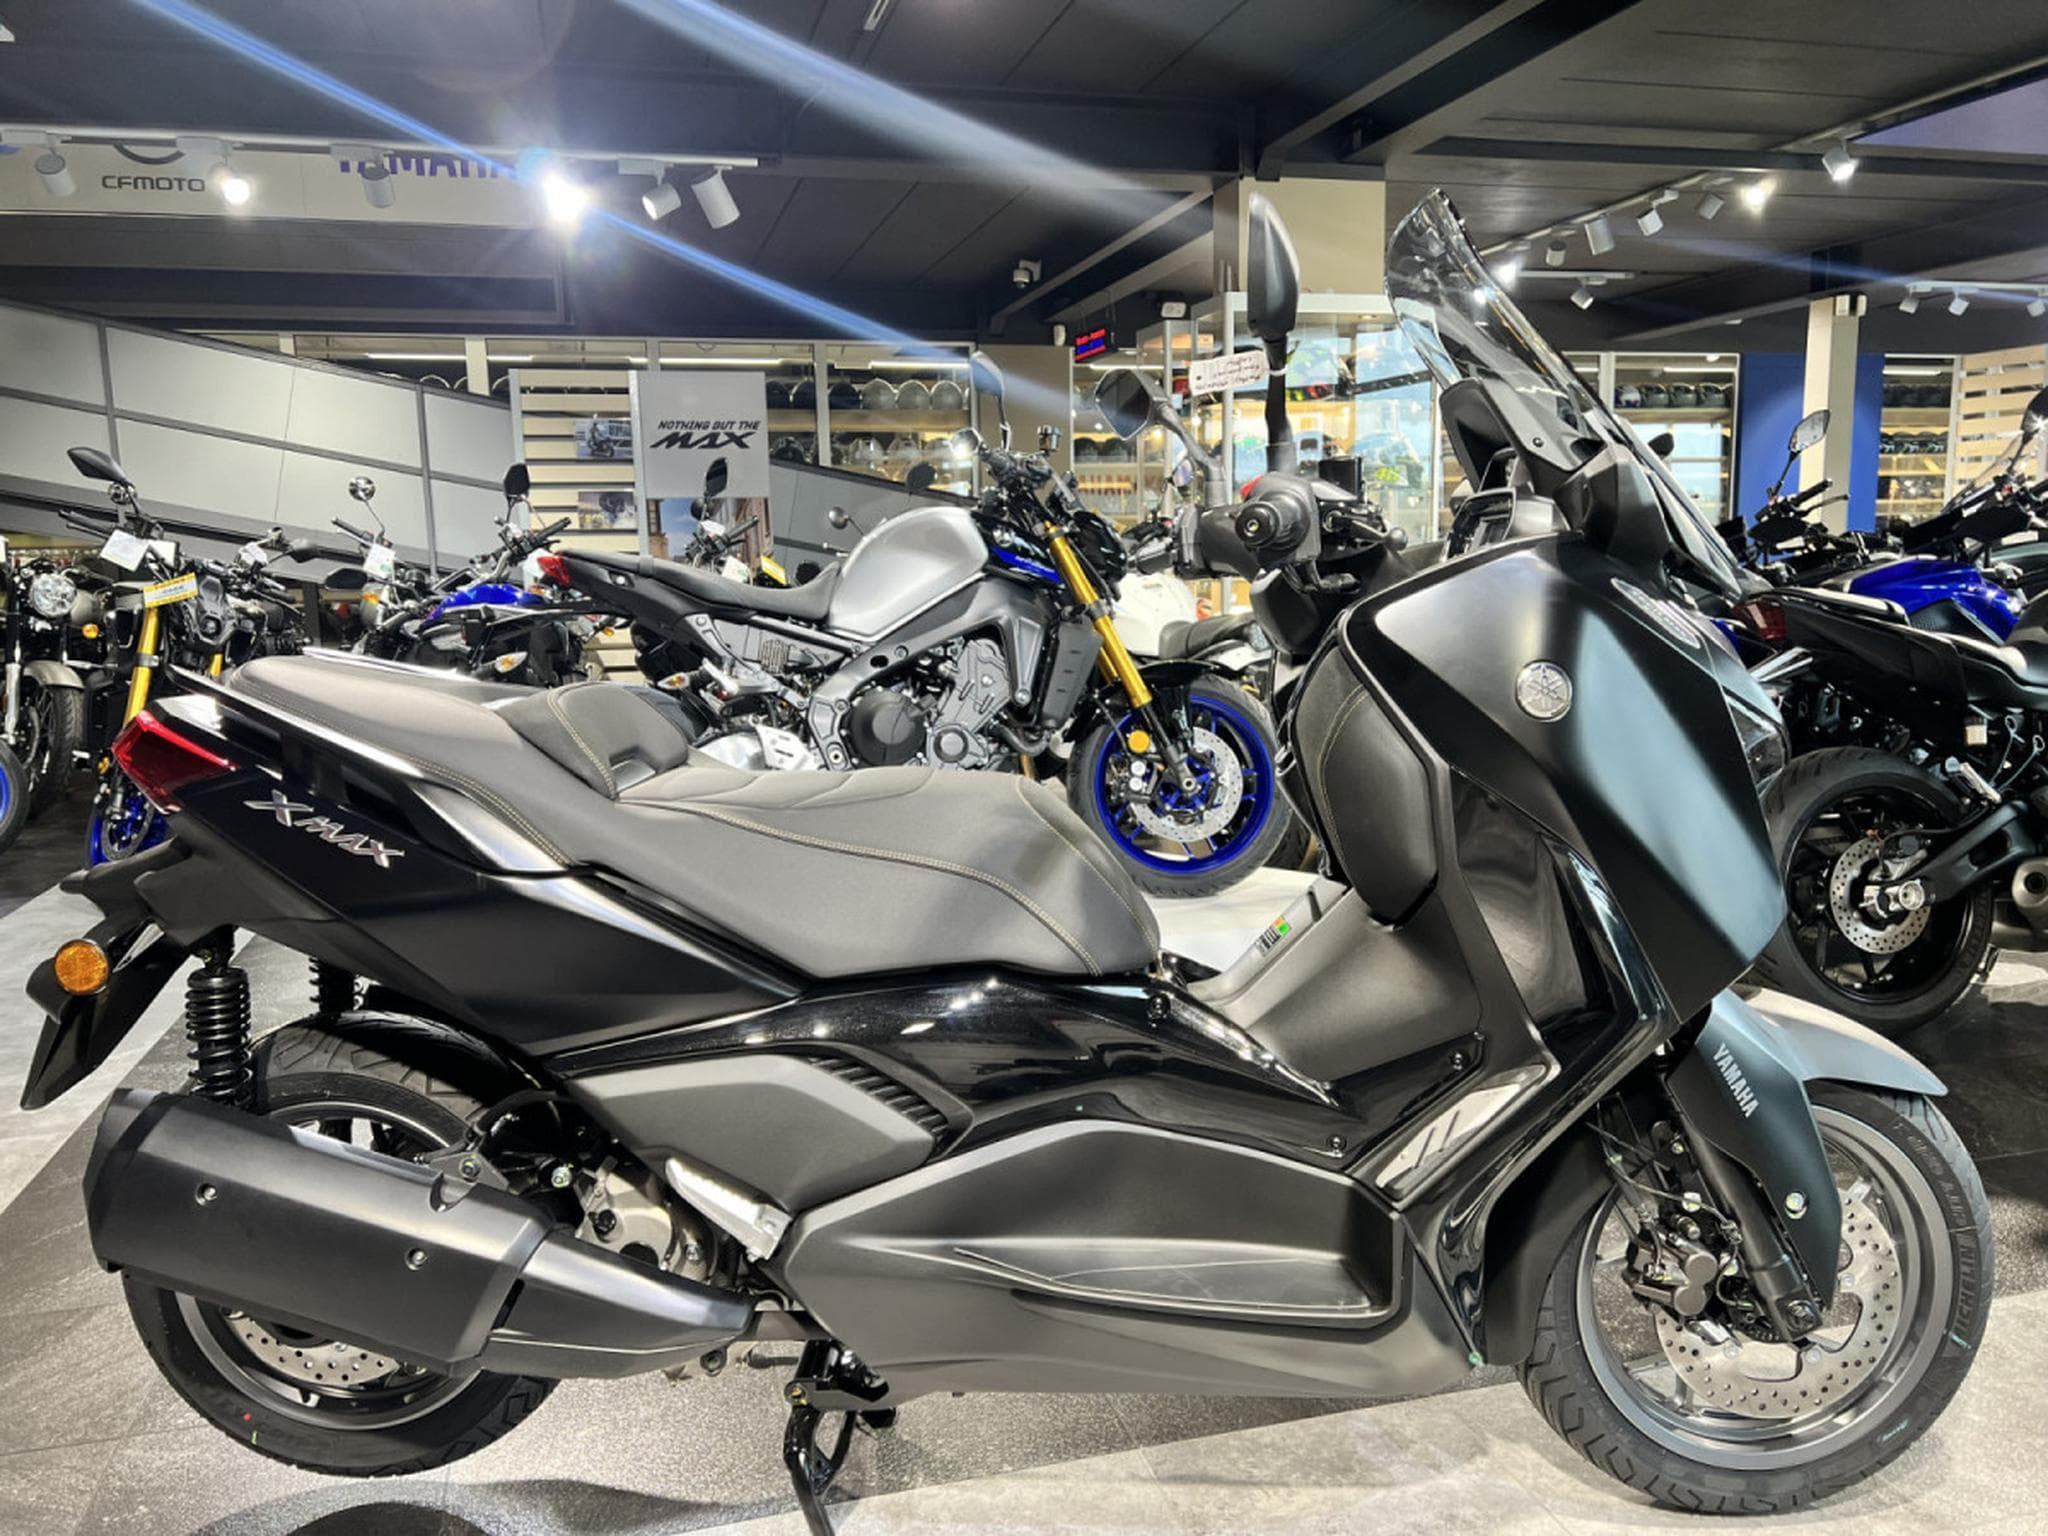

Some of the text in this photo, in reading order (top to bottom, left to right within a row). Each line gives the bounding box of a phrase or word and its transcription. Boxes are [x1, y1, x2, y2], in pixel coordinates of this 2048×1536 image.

[101, 175, 206, 192] CFMOTO
[658, 420, 761, 431] NOTHING BUT THE
[649, 431, 756, 449] MAX
[1712, 1042, 1760, 1119] YAMAHA
